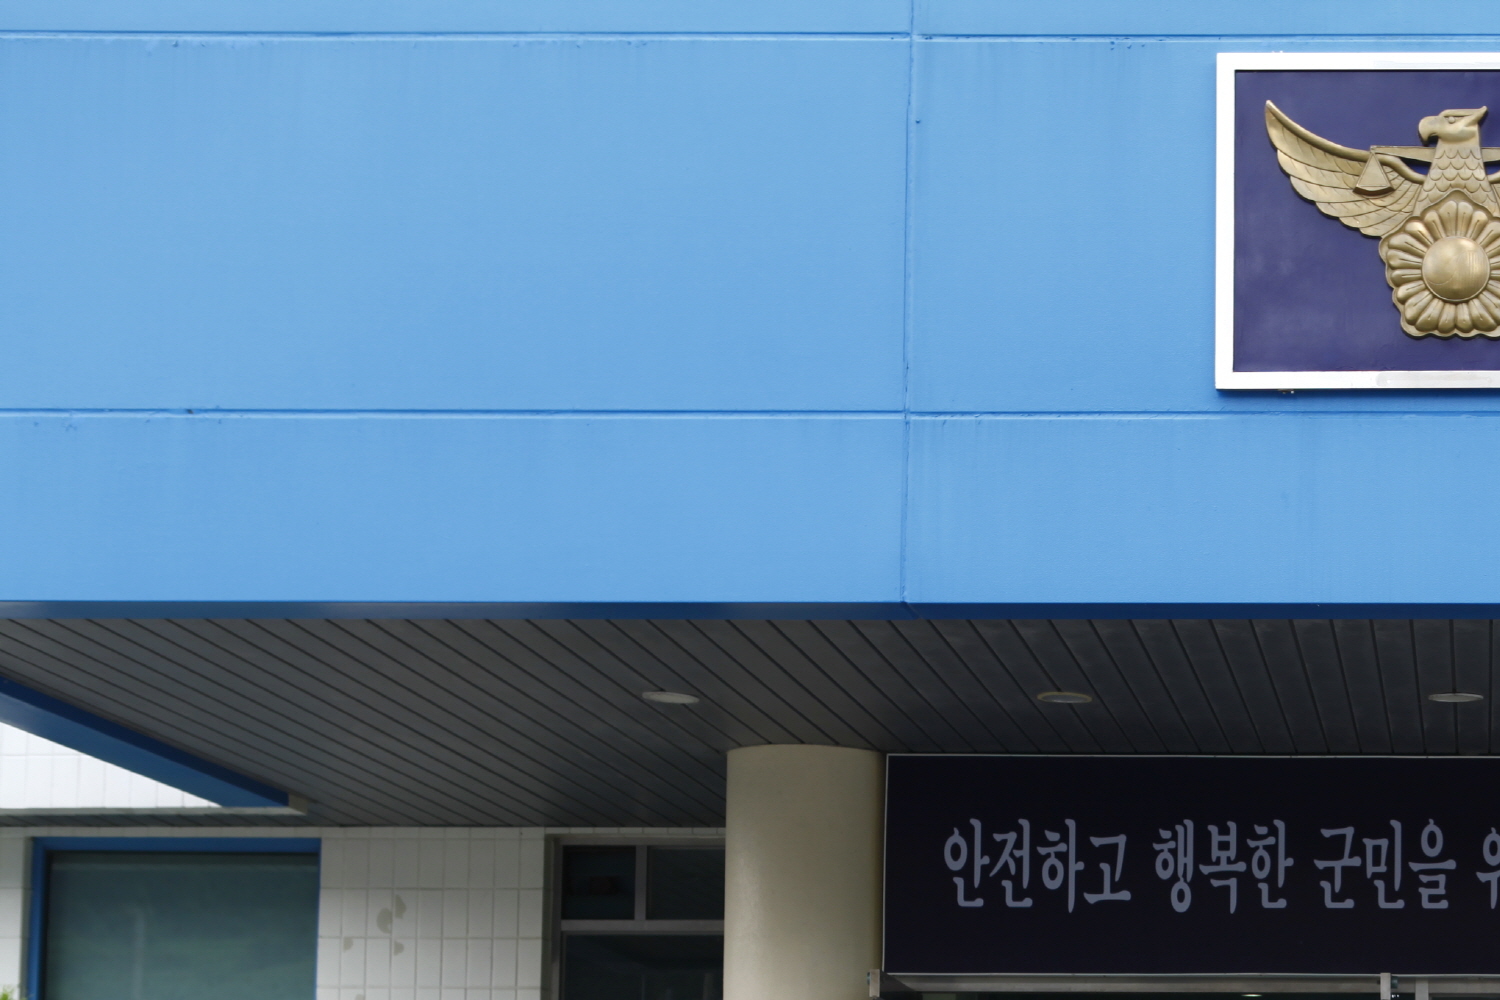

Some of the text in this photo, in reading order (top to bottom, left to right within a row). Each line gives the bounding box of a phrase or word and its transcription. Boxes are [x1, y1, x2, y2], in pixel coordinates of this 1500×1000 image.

[943, 818, 1132, 914] 안전하고
[1152, 818, 1295, 914] 행복한
[1313, 818, 1457, 911] 군민을
